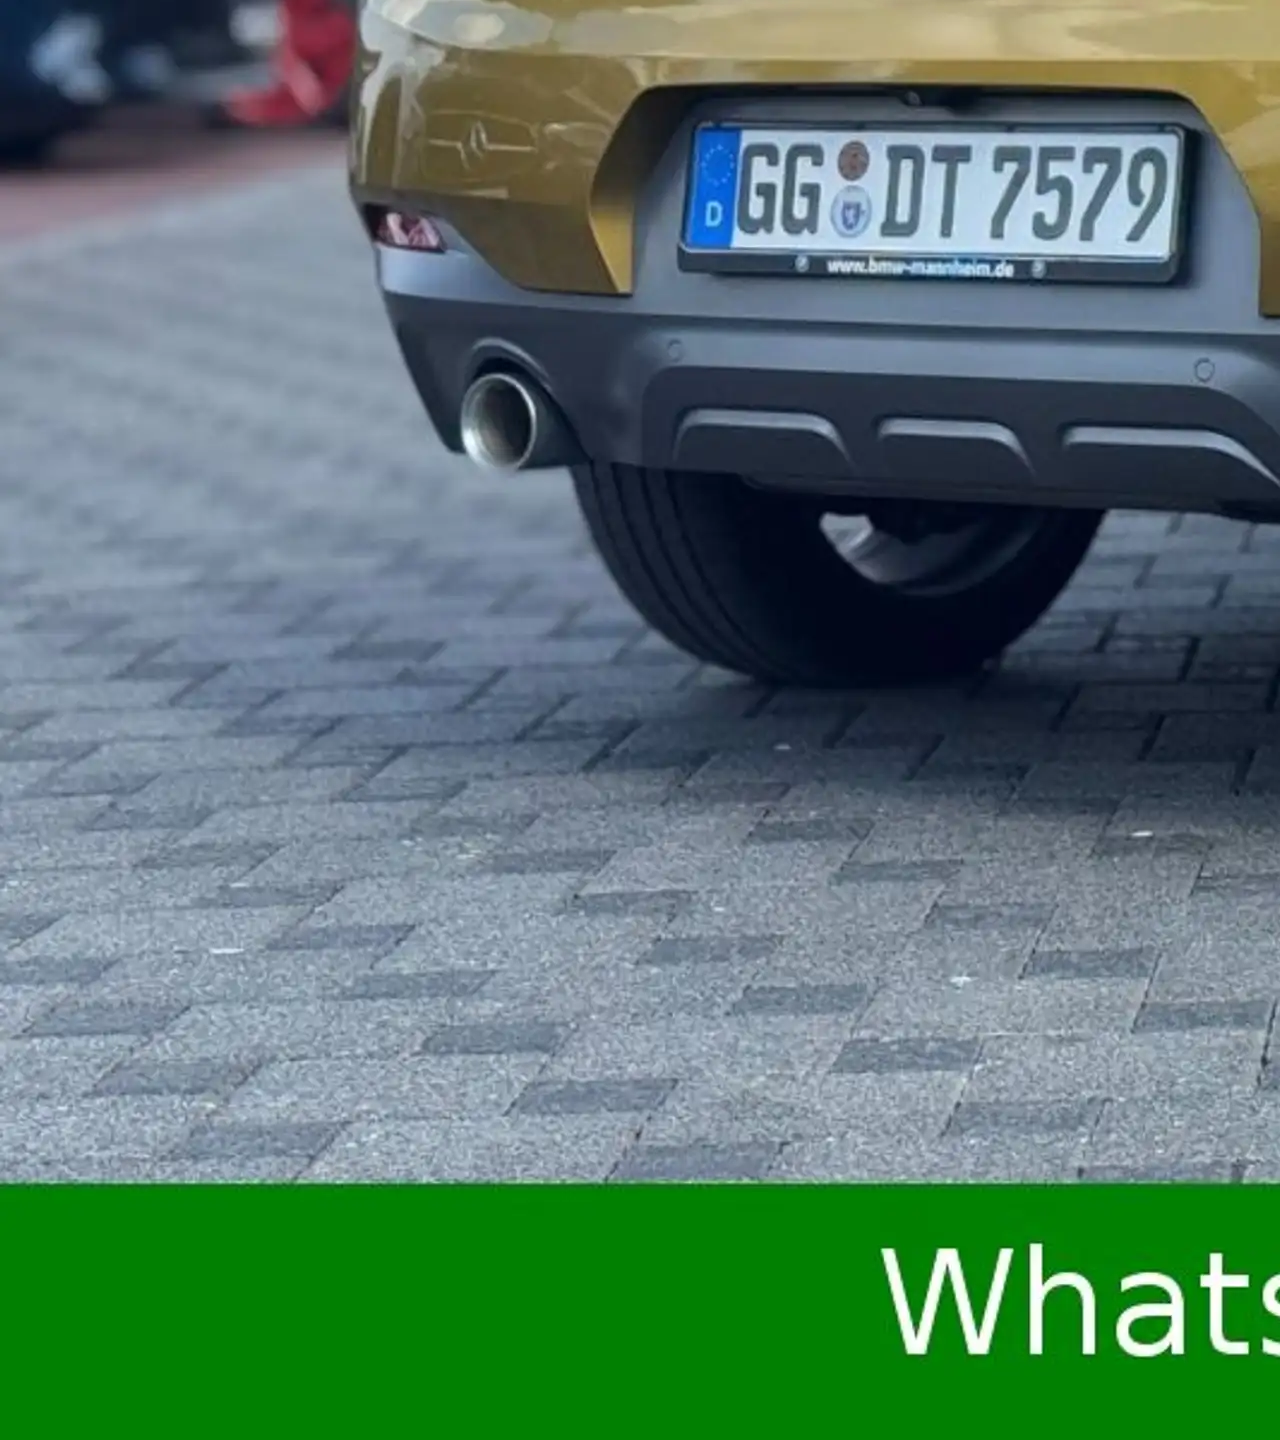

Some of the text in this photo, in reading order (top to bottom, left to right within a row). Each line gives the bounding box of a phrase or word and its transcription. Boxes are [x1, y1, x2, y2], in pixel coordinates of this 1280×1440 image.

[737, 142, 1169, 242] GG DT 7579
[705, 201, 724, 228] D
[827, 255, 1015, 278] www.bmw-mannheim.de
